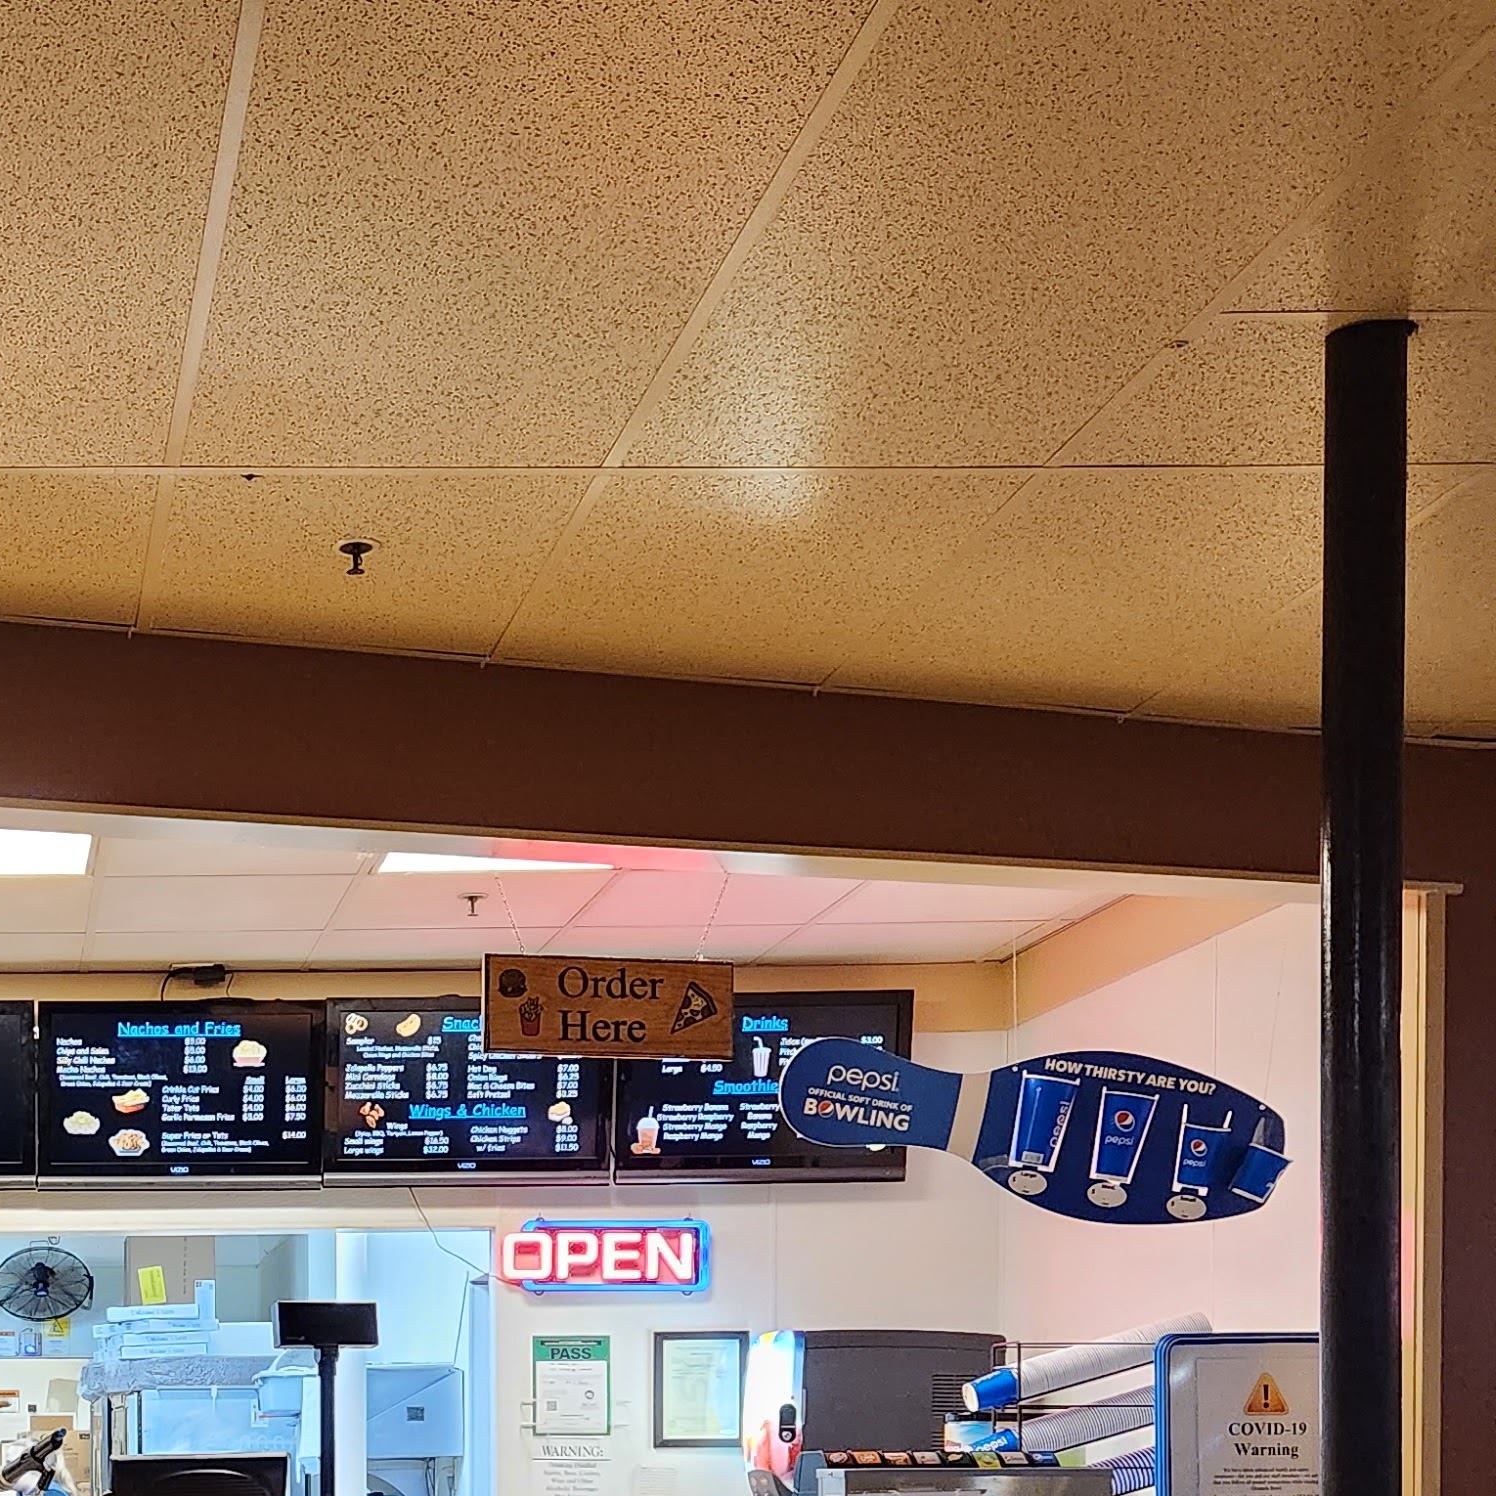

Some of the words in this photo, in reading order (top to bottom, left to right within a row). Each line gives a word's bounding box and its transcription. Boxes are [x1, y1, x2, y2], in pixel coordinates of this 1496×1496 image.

[558, 966, 665, 1000] Order
[558, 1009, 647, 1043] Here
[742, 1016, 789, 1030] Drinks
[117, 1022, 169, 1036] Nachos
[174, 1022, 200, 1036] and
[204, 1022, 241, 1036] Fries
[56, 1038, 83, 1046] Nachos
[56, 1047, 75, 1056] Chips
[75, 1047, 89, 1055] and
[467, 1065, 481, 1073] Hot
[483, 1065, 497, 1074] Dog
[557, 1064, 579, 1073] $7.00
[661, 1065, 683, 1075] Large
[345, 1073, 361, 1081] Mini
[826, 1065, 899, 1092] pepsi
[1044, 1058, 1083, 1075] HOW
[1084, 1064, 1149, 1084] THIRSTY
[1146, 1072, 1176, 1089] ARE
[1178, 1077, 1217, 1096] YOU?
[201, 1085, 220, 1094] Fries
[243, 1085, 264, 1094] $4.00
[345, 1082, 376, 1090] Zucchini
[377, 1082, 400, 1090] Sticks
[557, 1081, 578, 1090] $7.00
[162, 1095, 180, 1104] Curly
[181, 1095, 200, 1103] Fries
[242, 1094, 264, 1103] $4.00
[344, 1091, 384, 1099] Mozzarella
[385, 1091, 410, 1099] Sticks
[807, 1087, 847, 1101] OFFICIAL
[848, 1094, 872, 1105] SOFT
[871, 1099, 899, 1110] DRINK
[900, 1103, 913, 1112] OF
[242, 1103, 264, 1112] $4.00
[409, 1104, 451, 1120] Wings
[456, 1104, 467, 1116] &
[472, 1103, 526, 1116] Chicken
[662, 1104, 703, 1112] Strawberry
[704, 1103, 729, 1111] Banana
[739, 1103, 780, 1112] Strawberry
[216, 1113, 235, 1121] Fries
[657, 1114, 697, 1122] Strawberry
[698, 1113, 734, 1122] Raspberry
[386, 1122, 408, 1130] Wings
[470, 1126, 497, 1134] Chicken
[499, 1126, 528, 1135] Nuggets
[663, 1123, 704, 1132] Strawberry
[704, 1123, 727, 1131] Mango
[741, 1122, 778, 1130] Raspberry
[161, 1131, 183, 1141] Super
[183, 1131, 201, 1139] Fries
[470, 1135, 497, 1143] Chicken
[499, 1135, 521, 1144] Strips
[555, 1134, 577, 1142] $9.00
[663, 1132, 699, 1141] Raspberry
[700, 1132, 723, 1141] Mango
[747, 1132, 771, 1141] Mango
[1105, 1135, 1135, 1146] pepsi
[344, 1147, 364, 1156] Large
[1183, 1158, 1206, 1168] pepsi
[503, 1232, 693, 1280] OPEN
[550, 1347, 592, 1359] PASS
[1228, 1422, 1307, 1436] COVID-19
[541, 1445, 604, 1457] WARNING:
[1234, 1443, 1299, 1459] Warning
